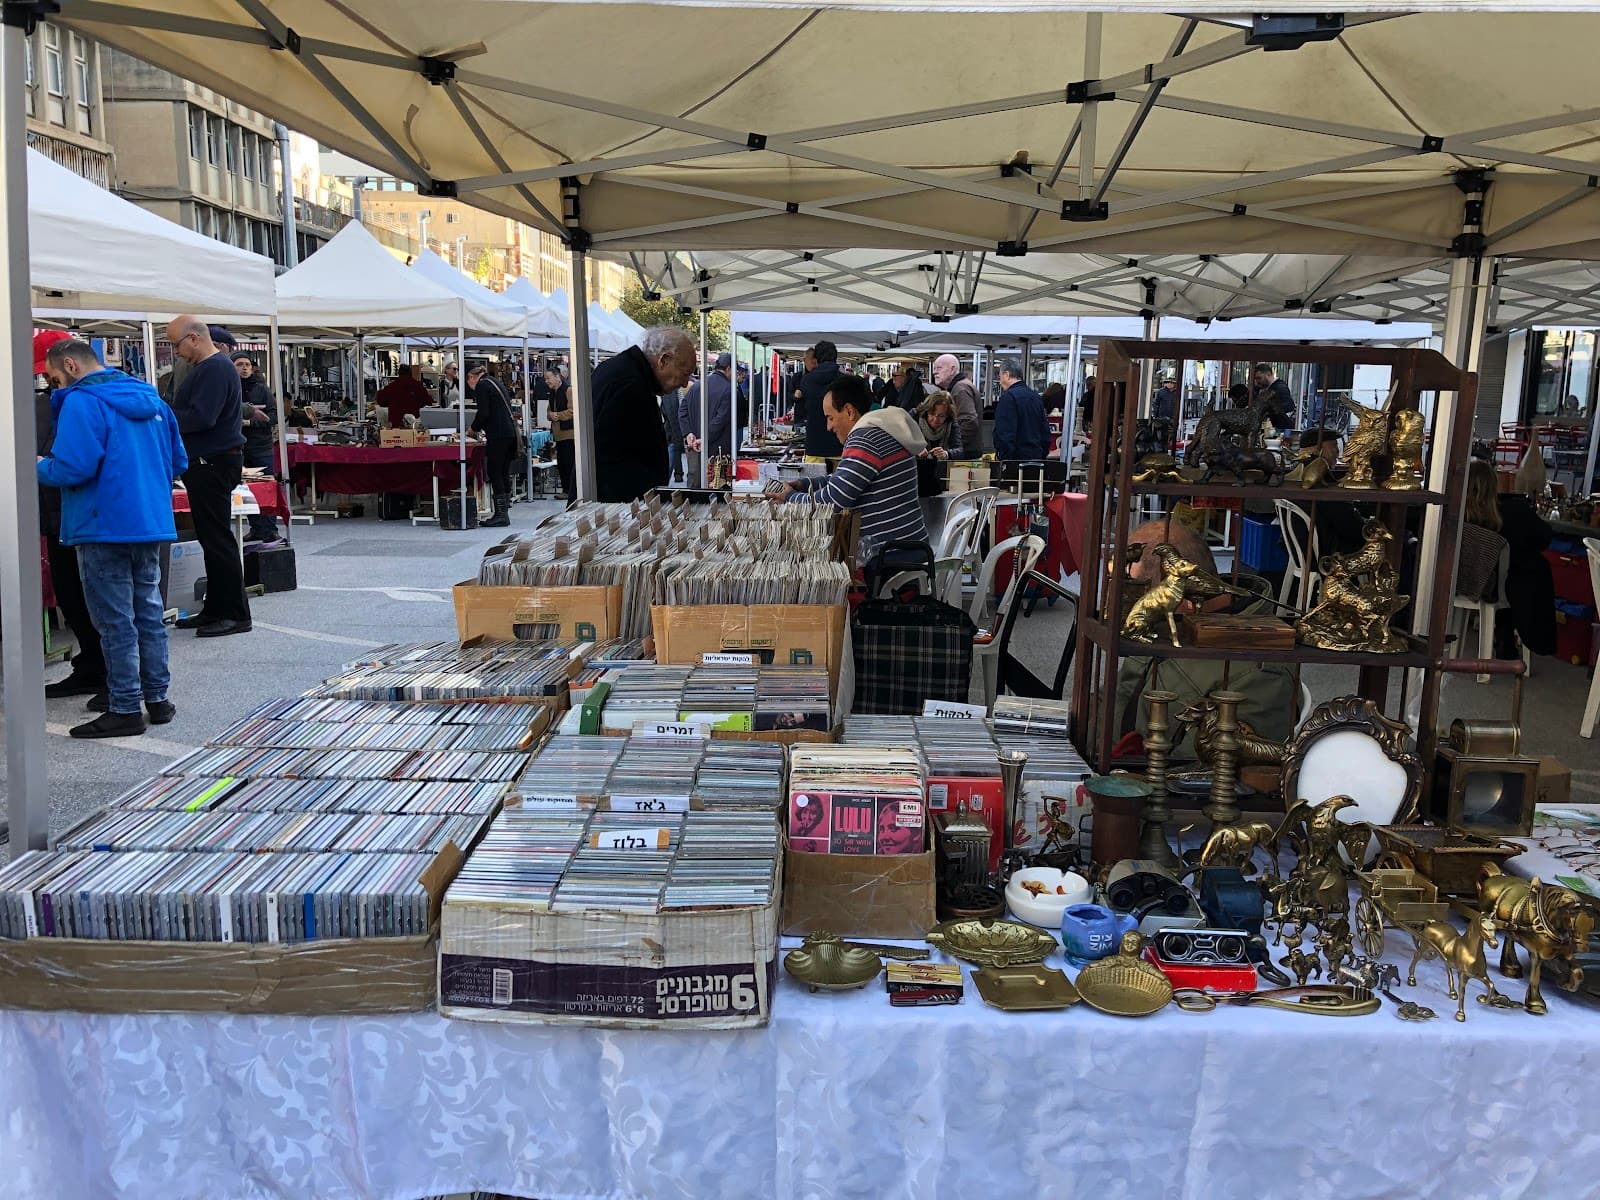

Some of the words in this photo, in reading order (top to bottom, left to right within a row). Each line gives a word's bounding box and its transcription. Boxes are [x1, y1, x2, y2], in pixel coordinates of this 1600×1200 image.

[934, 708, 973, 719] להקות
[656, 725, 695, 736] זמרים
[635, 799, 666, 811] ג'אז
[834, 806, 872, 833] LULU
[613, 835, 648, 849] בלוז
[656, 974, 729, 995] מגבונים
[731, 973, 756, 1010] 6
[630, 995, 645, 1004] 72
[655, 994, 729, 1014] שופרסל
